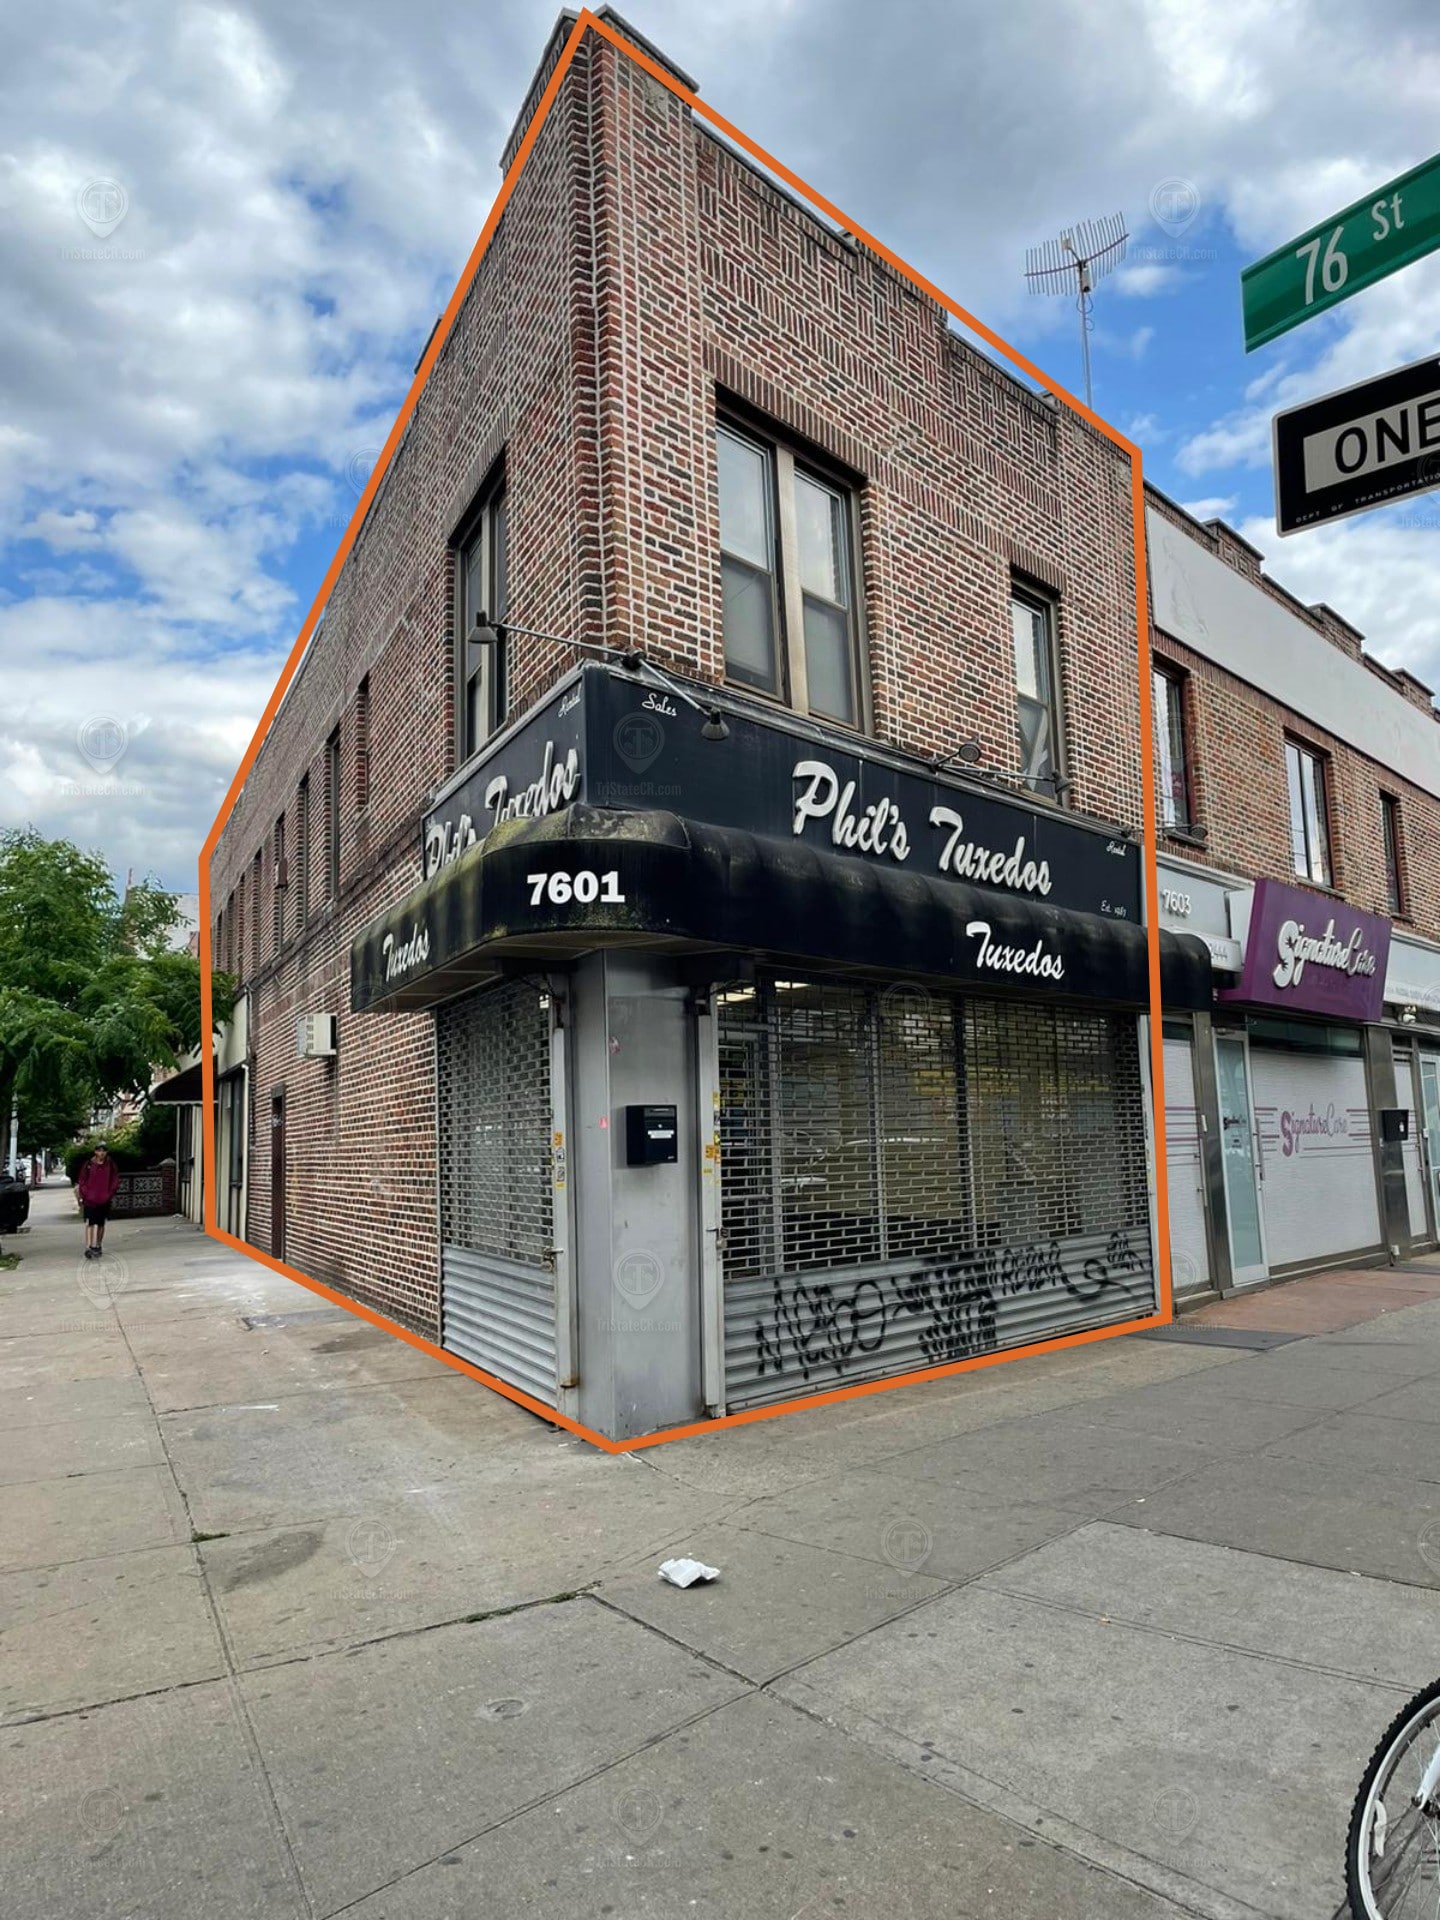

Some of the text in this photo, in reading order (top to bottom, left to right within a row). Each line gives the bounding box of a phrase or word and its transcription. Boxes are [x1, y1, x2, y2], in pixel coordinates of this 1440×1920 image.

[1296, 192, 1405, 305] 76 St
[1334, 400, 1440, 474] ONE
[641, 692, 677, 718] Sales
[792, 761, 1052, 896] Phil's Tuxedos
[527, 871, 625, 906] 7601
[1162, 888, 1192, 915] 7603
[382, 923, 431, 983] Tuxedos
[966, 921, 1064, 980] Tuxedos
